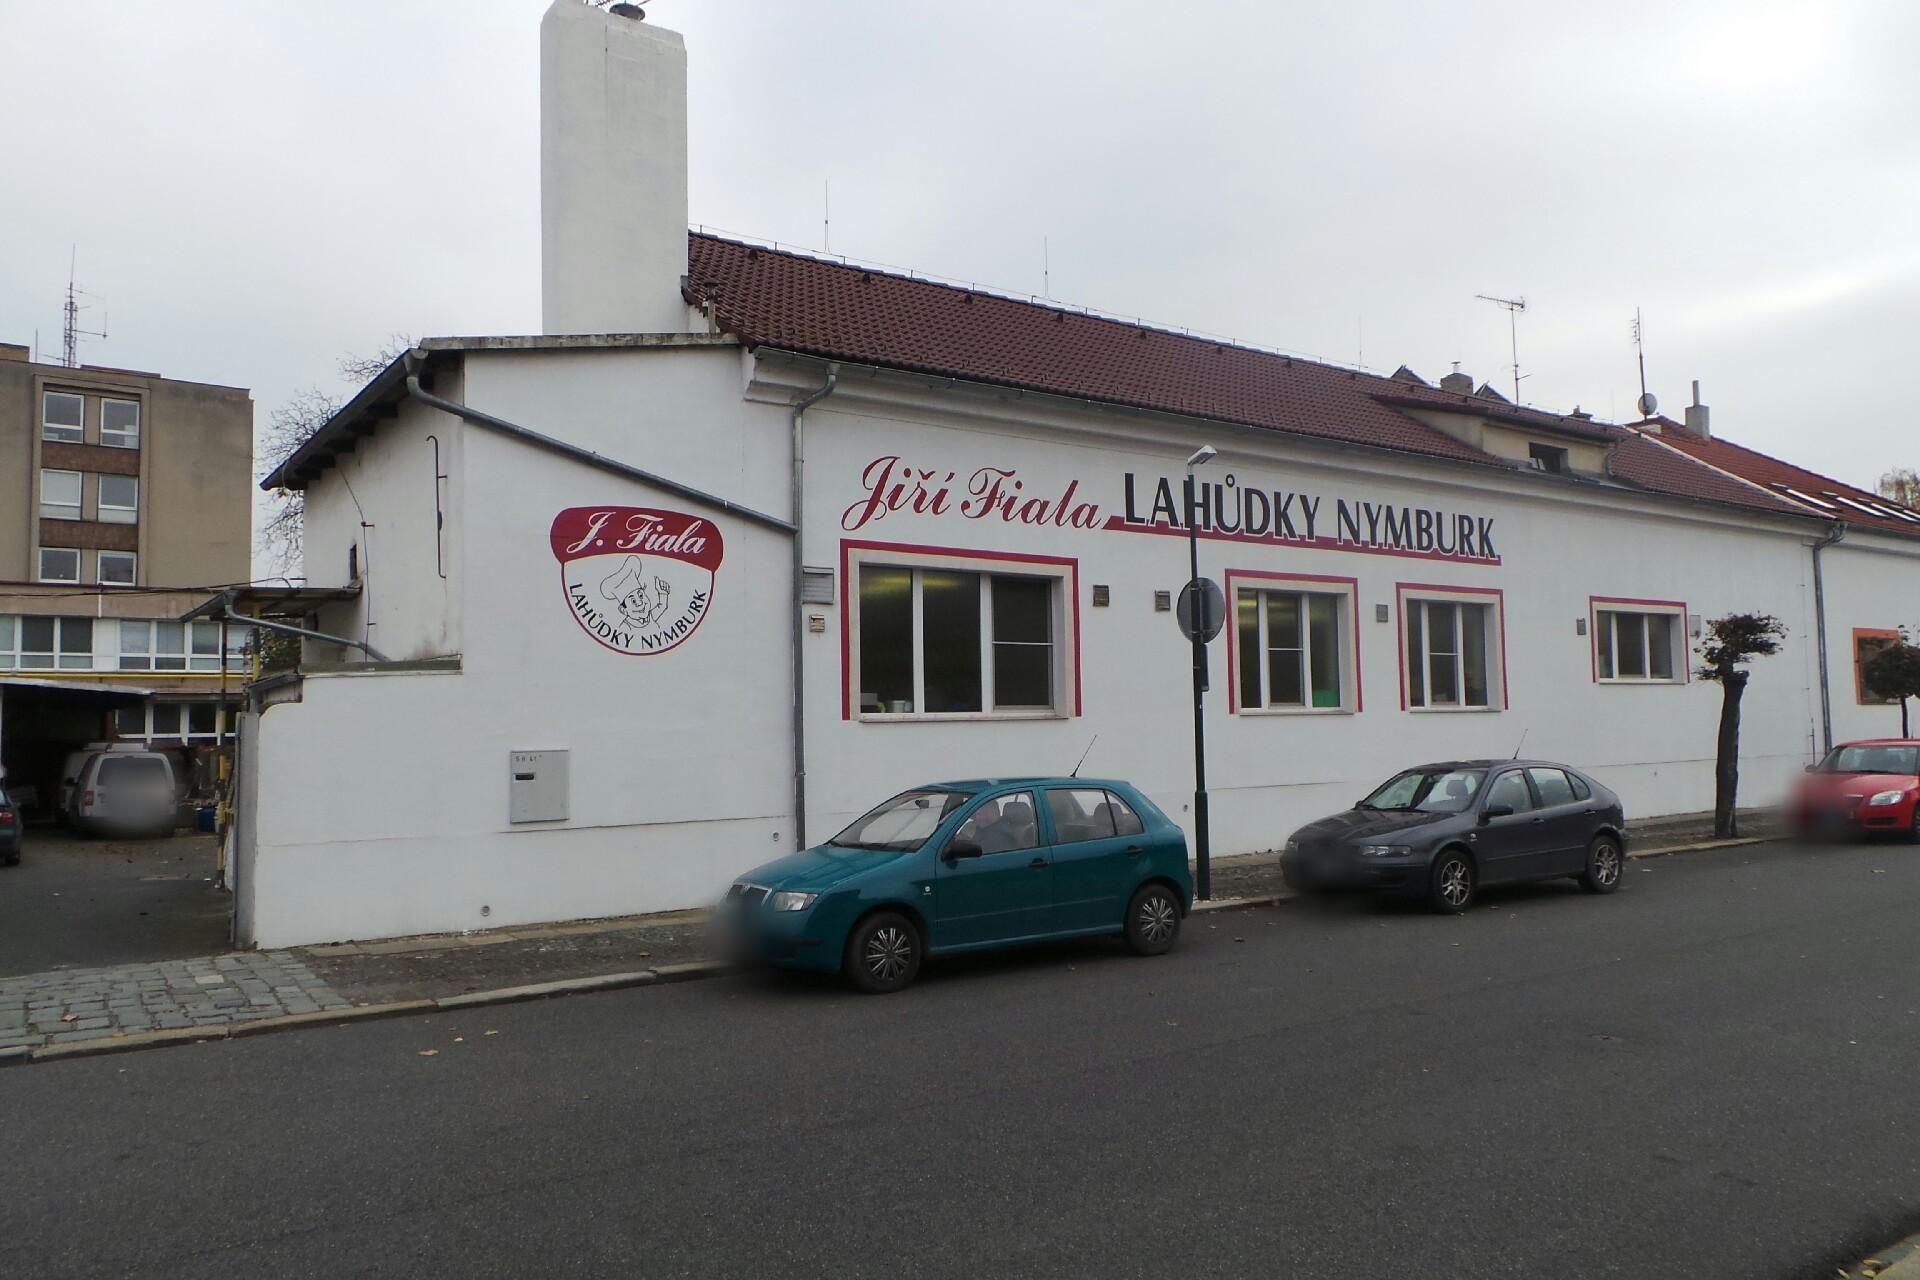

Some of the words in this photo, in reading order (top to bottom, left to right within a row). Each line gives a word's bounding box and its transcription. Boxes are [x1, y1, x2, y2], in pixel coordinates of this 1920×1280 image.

[566, 511, 616, 553] J.
[616, 514, 706, 554] Fiala
[840, 456, 955, 531] Jiří
[961, 467, 1101, 529] Fiala
[1124, 473, 1320, 541] LAHŮDKY
[1337, 499, 1498, 558] NYMBURK
[569, 583, 634, 649] LAHŮDKY
[641, 589, 706, 649] NYMBURK
